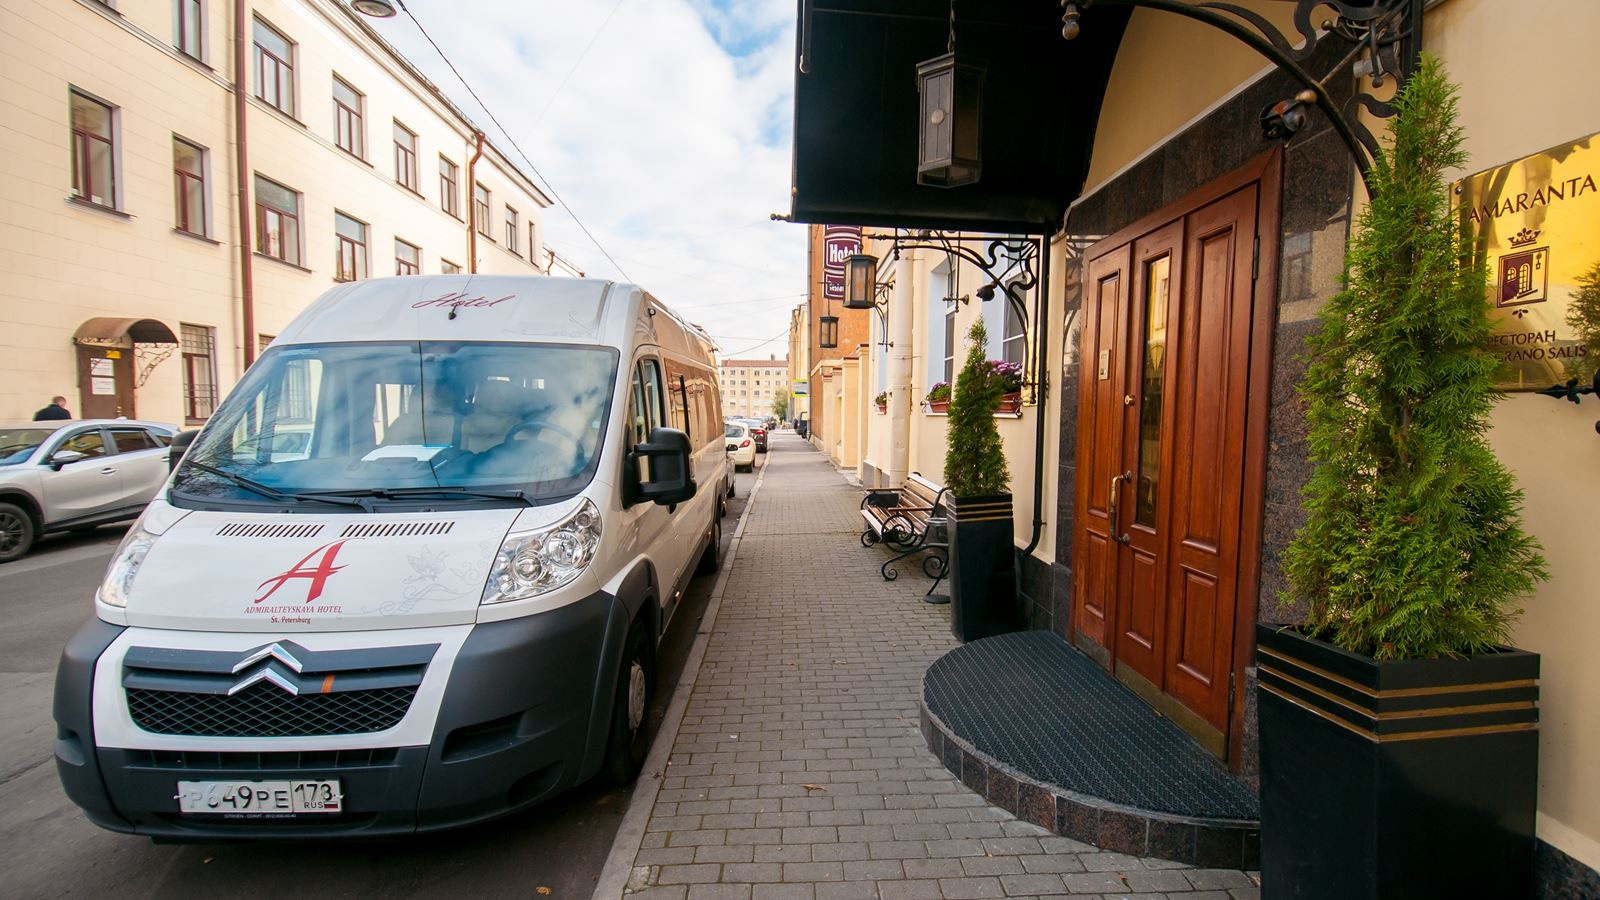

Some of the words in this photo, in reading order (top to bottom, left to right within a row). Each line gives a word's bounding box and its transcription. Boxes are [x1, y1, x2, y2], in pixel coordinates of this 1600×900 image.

[1469, 174, 1598, 224] AMARANTA
[411, 292, 516, 309] Hotel
[1547, 344, 1588, 360] SALIS
[244, 605, 314, 614] ADMIRALTEYSKAYA
[317, 605, 342, 614] HOTEL
[281, 615, 311, 625] Petersburg
[304, 801, 323, 809] RUS
